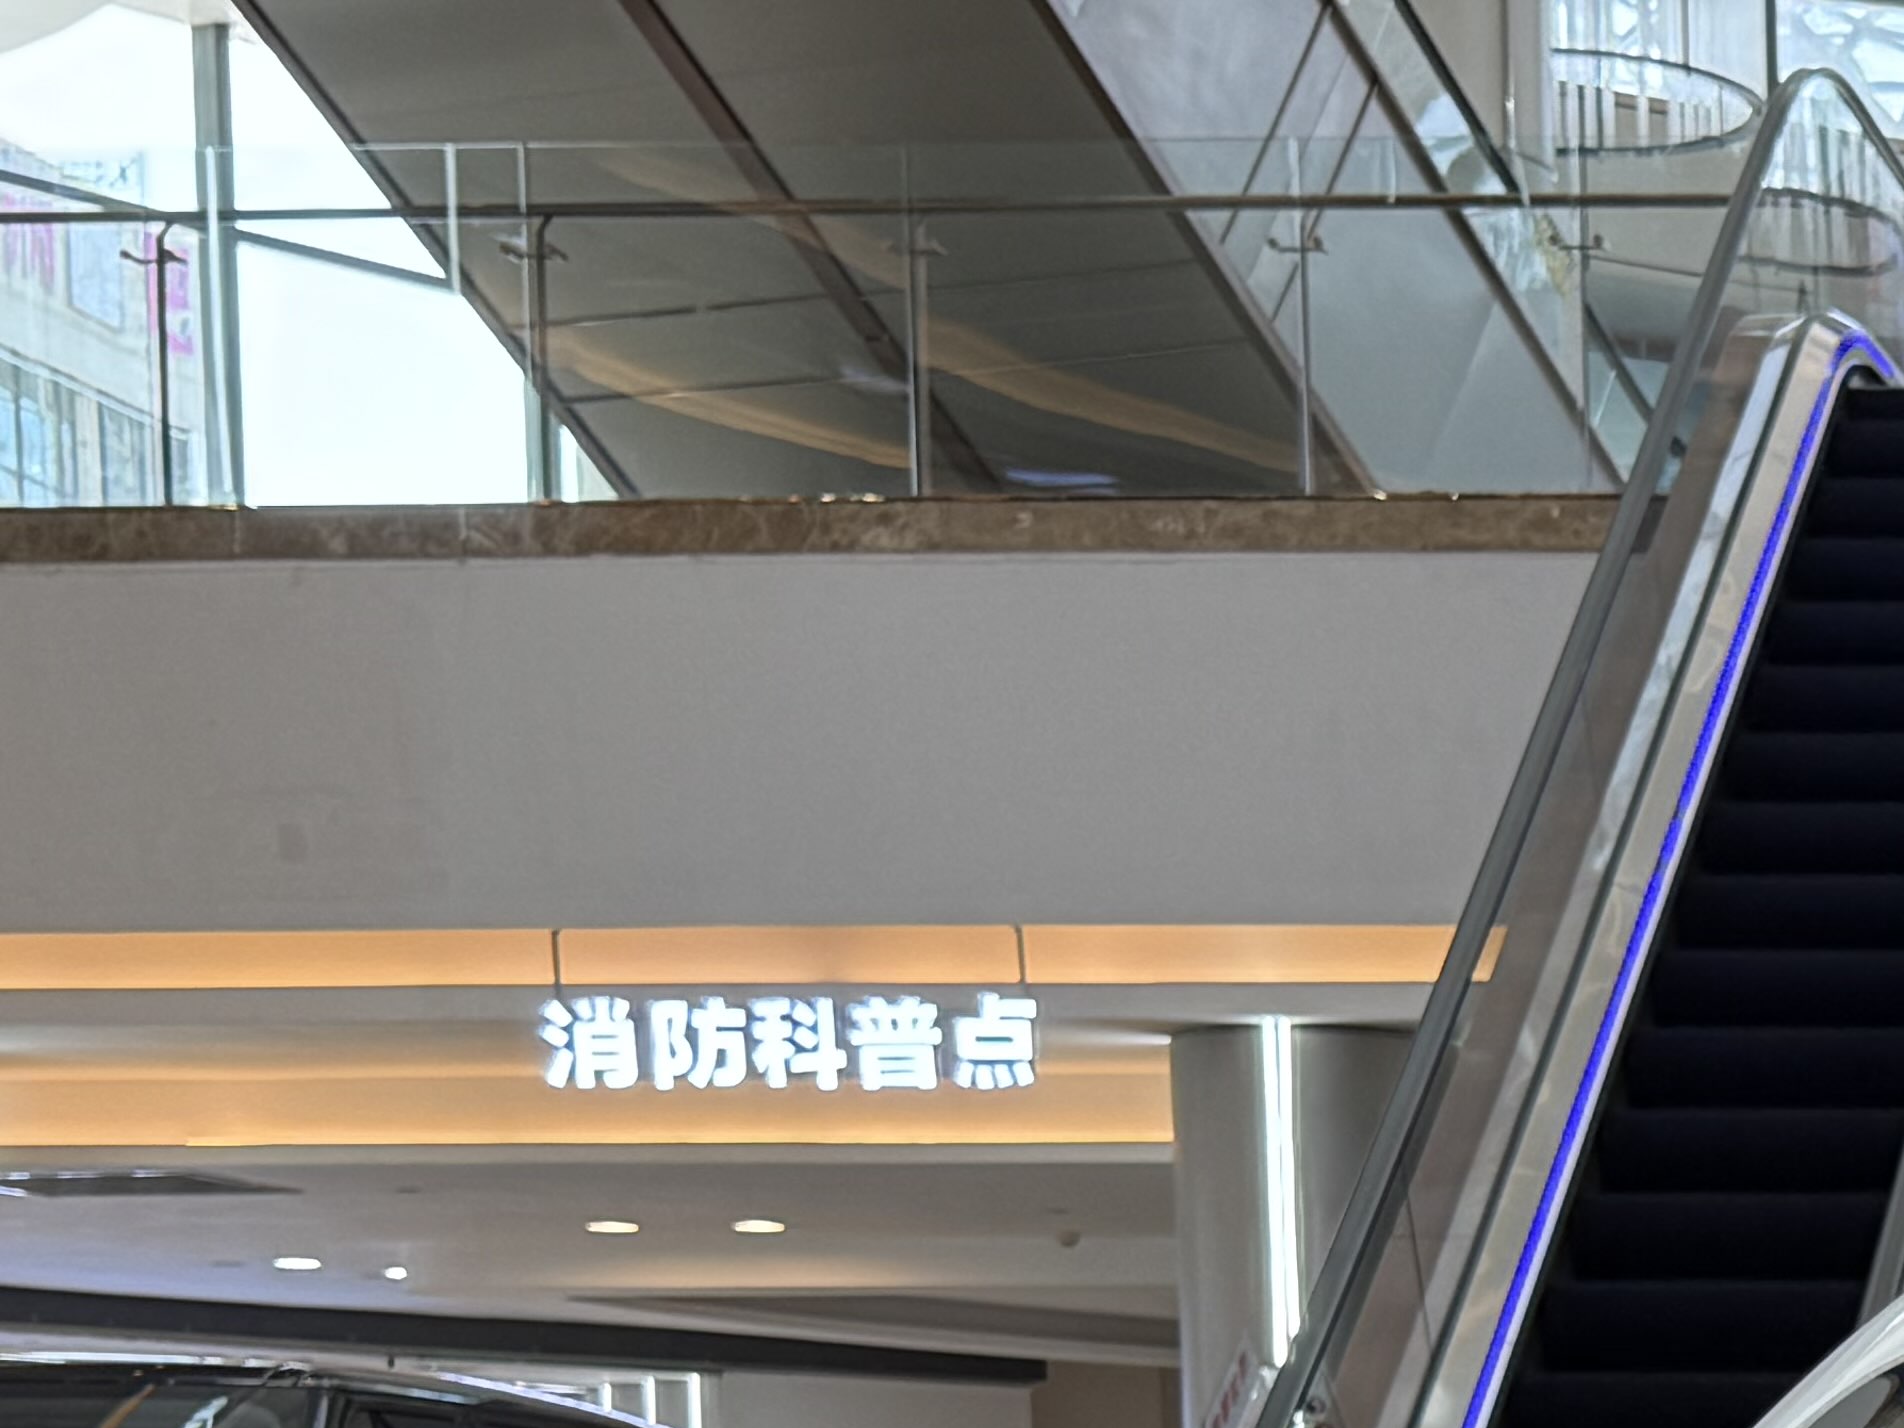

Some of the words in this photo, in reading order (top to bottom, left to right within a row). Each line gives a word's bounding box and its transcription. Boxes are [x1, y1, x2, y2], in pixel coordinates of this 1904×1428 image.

[538, 991, 1038, 1092] 消防科普点
